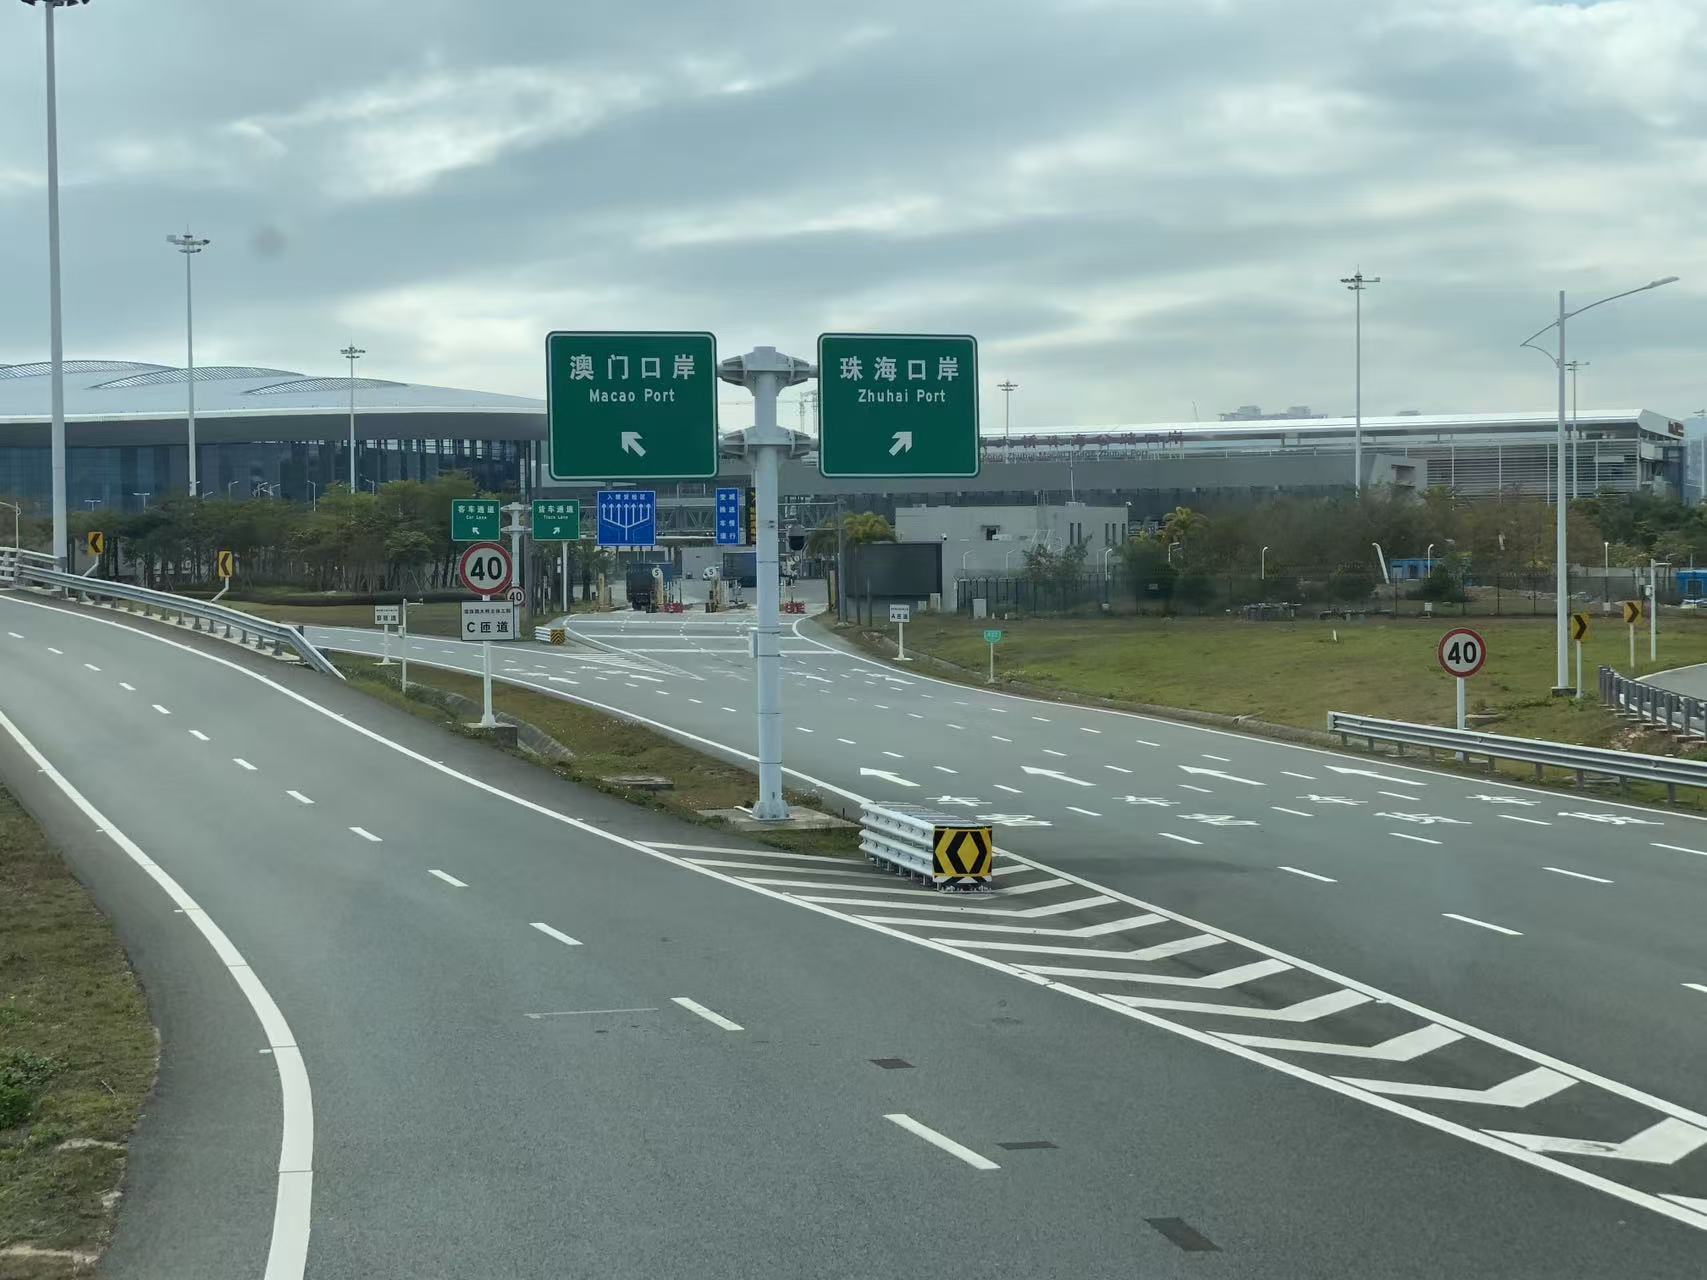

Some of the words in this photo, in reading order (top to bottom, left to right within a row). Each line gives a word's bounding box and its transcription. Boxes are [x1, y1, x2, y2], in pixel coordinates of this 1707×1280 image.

[569, 354, 696, 380] 澳门口岸
[839, 356, 960, 382] 珠海口岸
[589, 388, 636, 402] Macao
[644, 388, 675, 402] Port
[858, 389, 909, 402] Zhuhai
[916, 389, 946, 402] Port
[458, 505, 495, 514] 客车通道
[538, 505, 574, 514] 货车通道
[470, 556, 503, 581] 40
[509, 591, 522, 602] 40
[467, 620, 509, 633] C匝道
[1447, 640, 1477, 664] 40
